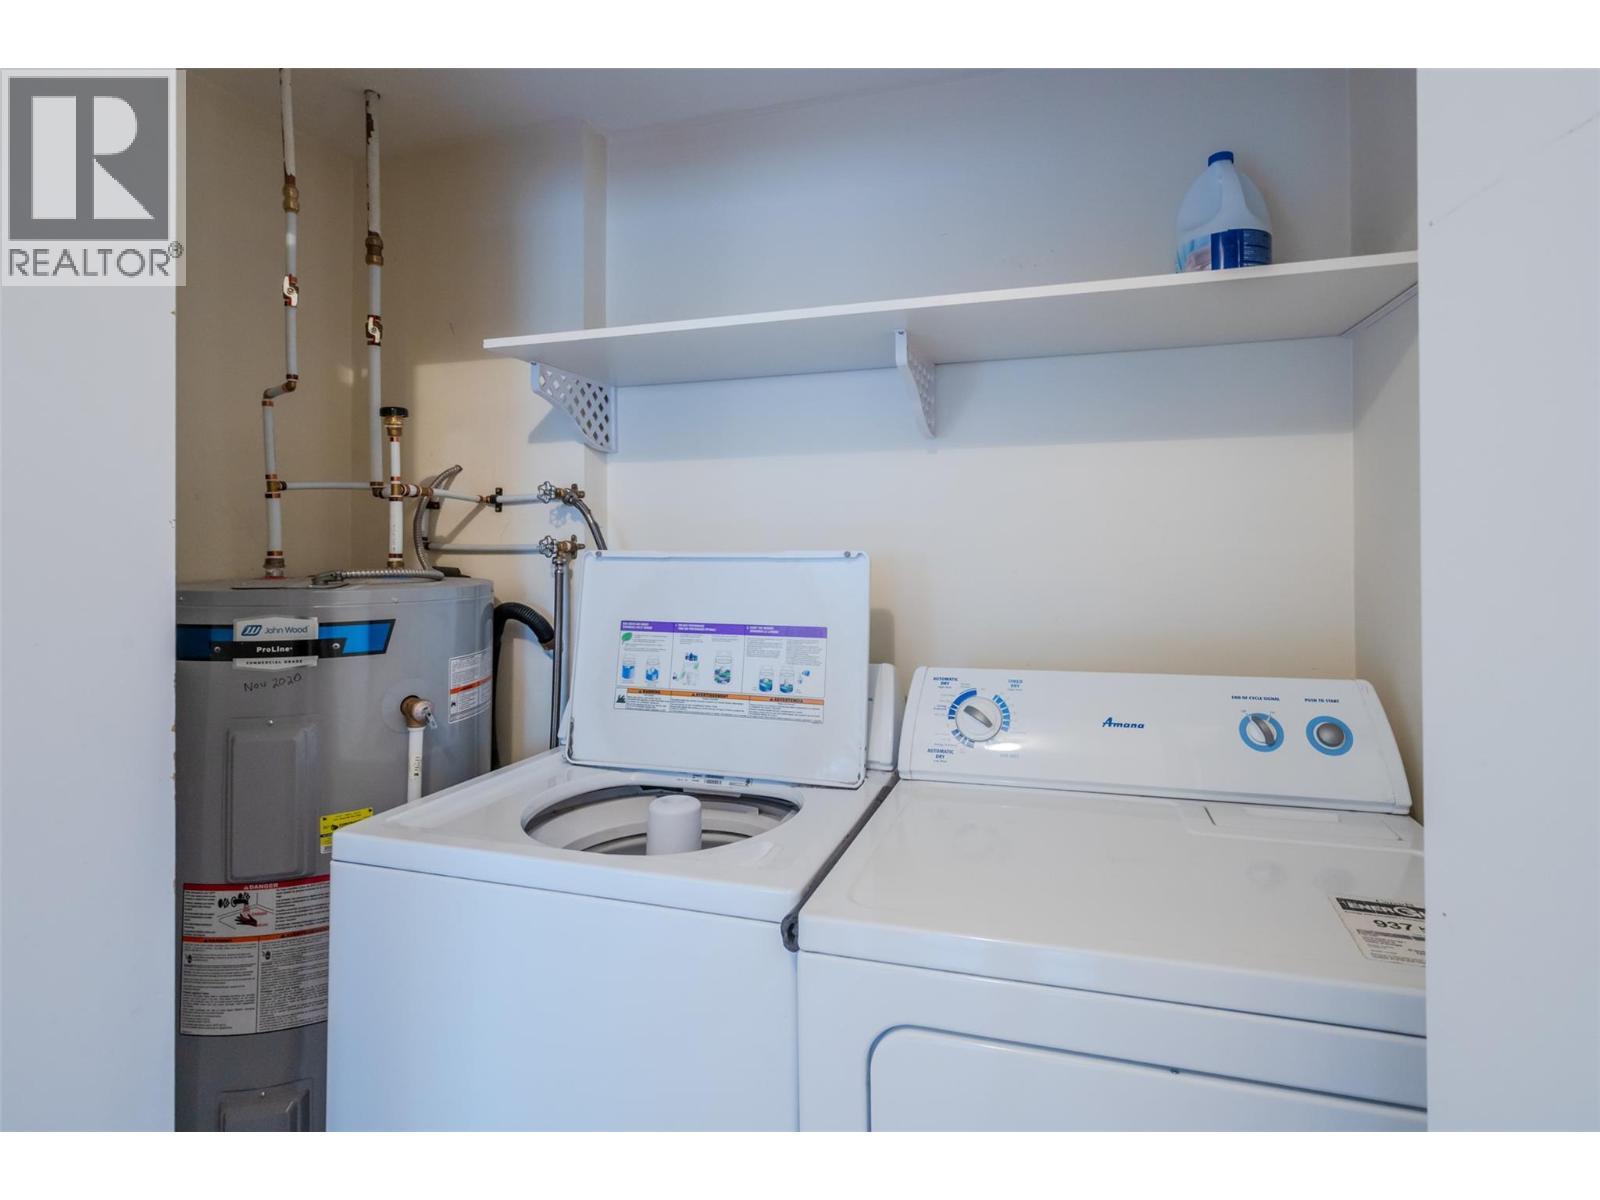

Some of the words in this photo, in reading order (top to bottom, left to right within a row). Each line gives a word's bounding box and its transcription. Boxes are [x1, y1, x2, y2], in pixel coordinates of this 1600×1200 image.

[265, 625, 284, 634] John
[272, 672, 302, 688] 2020
[1102, 717, 1144, 729] Amana
[1373, 919, 1412, 931] 937
